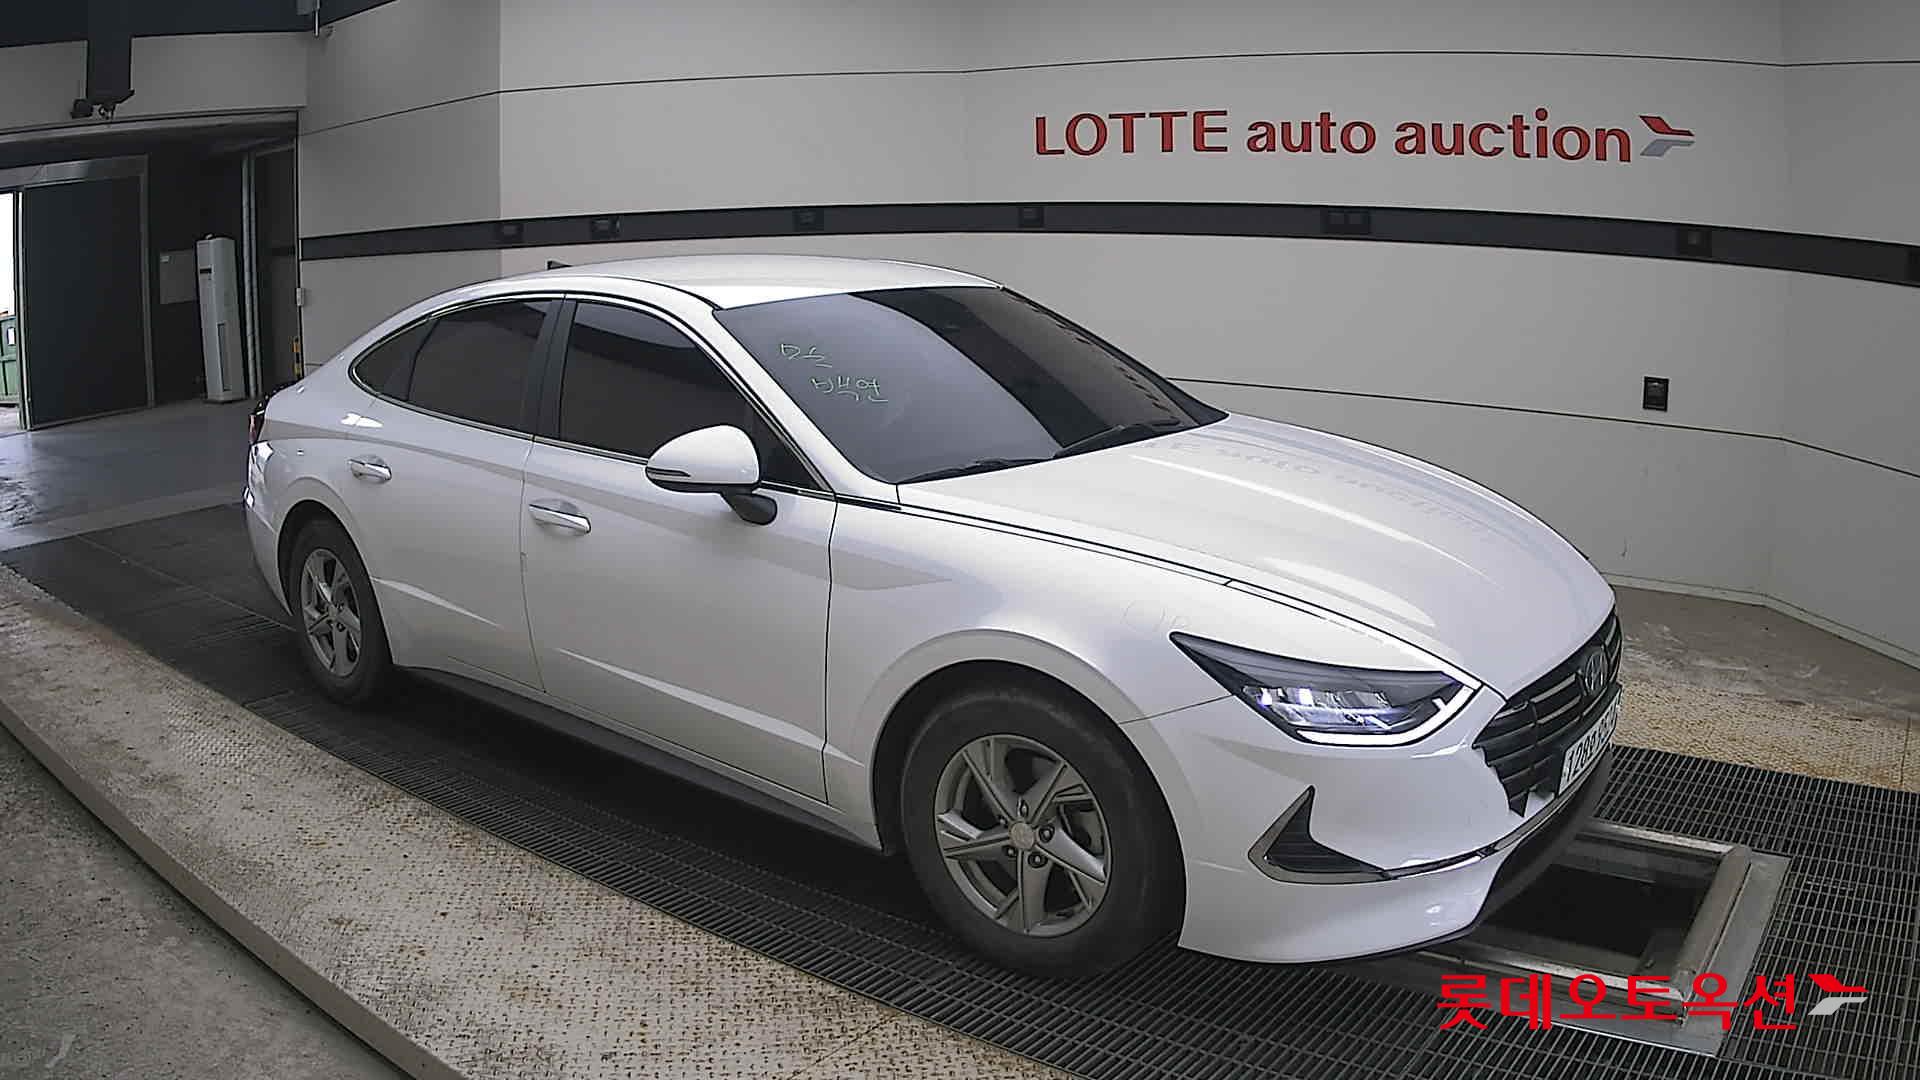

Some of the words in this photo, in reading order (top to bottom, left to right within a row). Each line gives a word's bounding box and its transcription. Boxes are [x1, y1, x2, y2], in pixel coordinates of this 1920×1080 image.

[1035, 110, 1229, 157] LOTTE
[1246, 111, 1376, 155] auto
[1395, 107, 1632, 163] auction
